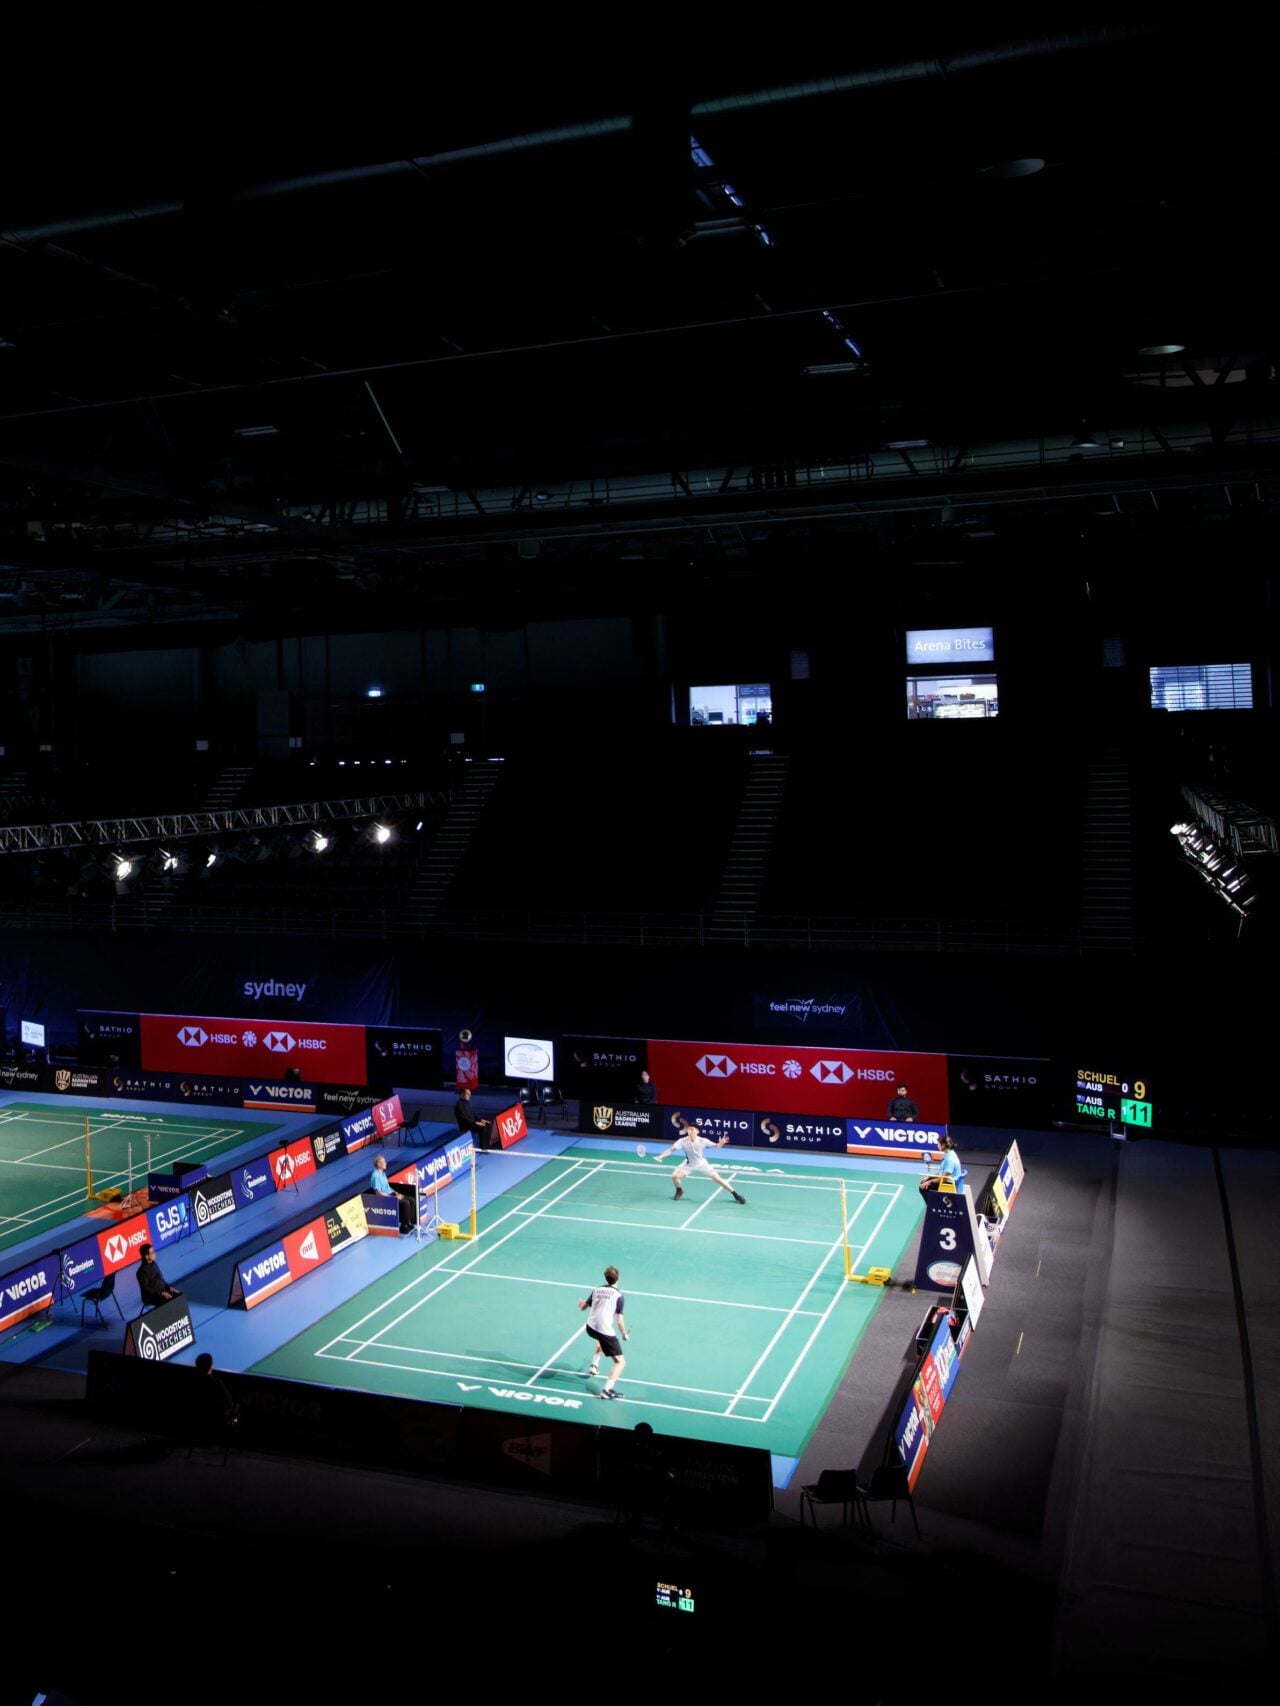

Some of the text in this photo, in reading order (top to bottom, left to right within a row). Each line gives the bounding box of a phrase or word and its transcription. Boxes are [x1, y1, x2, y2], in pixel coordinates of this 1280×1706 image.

[915, 638, 986, 653] Arena Bites
[244, 978, 306, 1002] sydney
[770, 1001, 846, 1015] feel new sydney
[99, 1025, 132, 1034] SATHIO
[210, 1033, 237, 1045] HSBC
[298, 1038, 327, 1050] HSBC
[392, 1044, 432, 1053] SATHIO
[593, 1053, 637, 1062] SATHIO
[16, 1070, 39, 1081] sydney
[740, 1063, 776, 1075] HSBC
[857, 1069, 895, 1082] HSBC
[127, 1080, 170, 1088] SATHIO
[984, 1074, 1037, 1084] SATHIO
[1077, 1070, 1120, 1086] SCHUEL
[194, 1084, 239, 1094] SATHIO
[265, 1086, 312, 1100] VICTOR
[1086, 1082, 1128, 1093] AUS 0
[1134, 1081, 1146, 1099] 9
[324, 1092, 338, 1101] feel
[338, 1094, 355, 1102] new
[1085, 1096, 1102, 1106] AUS
[379, 1103, 394, 1122] S P
[615, 1110, 650, 1118] AUSTRALIAN
[1076, 1103, 1116, 1119] TANG R
[1130, 1103, 1148, 1124] 11
[695, 1118, 748, 1129] SATHIO
[786, 1124, 842, 1136] SATHIO
[874, 1126, 939, 1144] VICTOR
[207, 1189, 233, 1205] WOODSTONE
[209, 1197, 234, 1214] KITCHENS
[371, 1207, 396, 1216] VICTOR
[155, 1205, 180, 1233] GJS
[128, 1229, 147, 1247] HSBC
[939, 1227, 957, 1251] 3
[68, 1259, 94, 1277] Badminton
[253, 1251, 286, 1279] VICTOR
[6, 1271, 46, 1301] VICTOR
[156, 1315, 189, 1340] WOODSTONE
[158, 1326, 192, 1352] KITCHENS
[488, 1387, 583, 1409] VICTOR
[685, 1588, 691, 1598] 9
